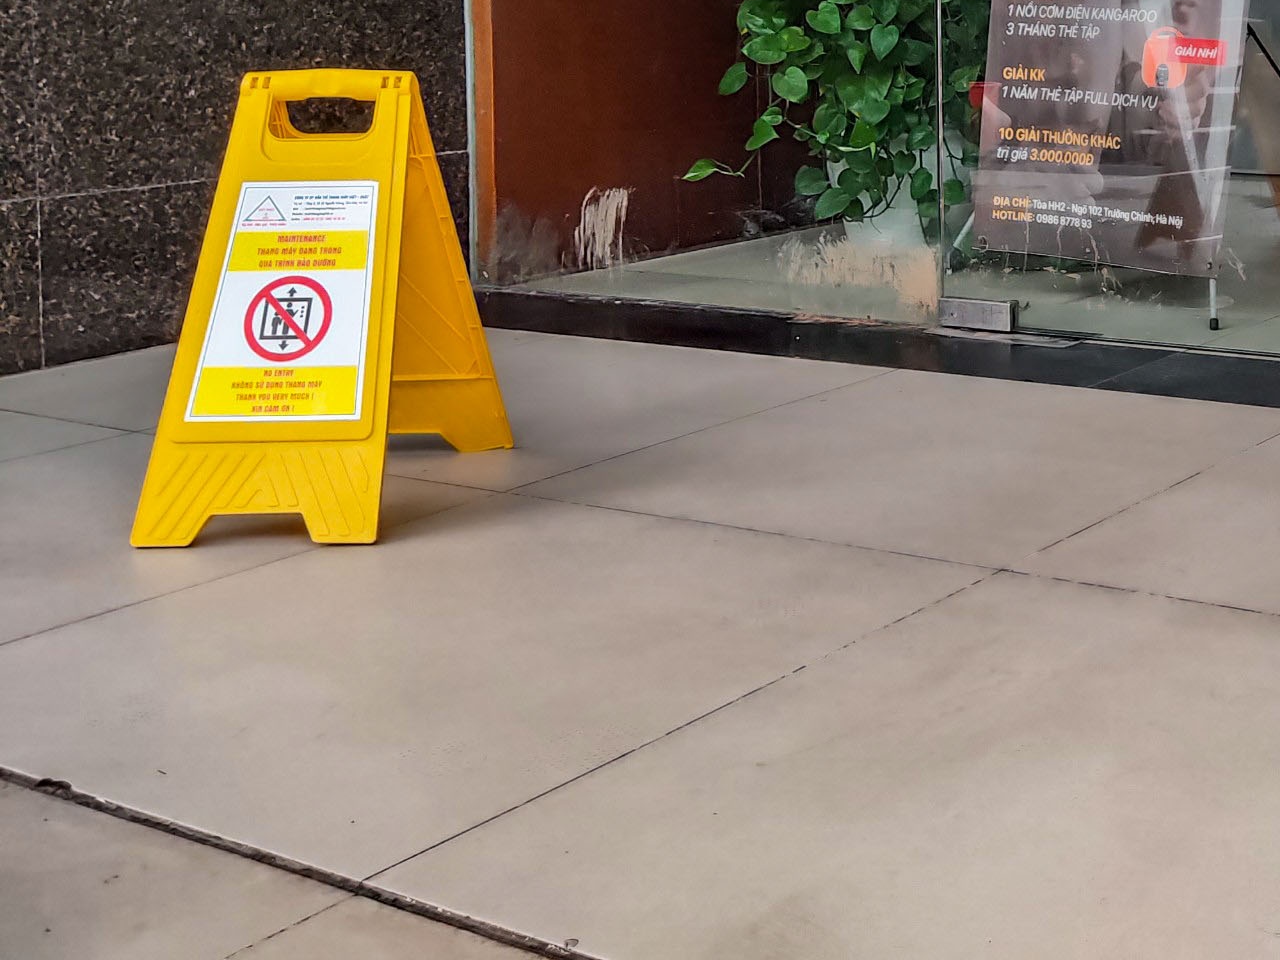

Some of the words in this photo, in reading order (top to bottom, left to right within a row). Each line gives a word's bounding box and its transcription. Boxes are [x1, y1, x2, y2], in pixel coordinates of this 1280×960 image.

[1007, 4, 1014, 16] 1
[1016, 1, 1037, 18] NỒI
[1038, 5, 1064, 19] CƠM
[1065, 4, 1090, 21] ĐIỆN
[1090, 7, 1158, 23] KANGAROO
[1002, 85, 1008, 98] 1
[1010, 84, 1038, 99] NĂM
[1063, 87, 1083, 105] TẬP
[1084, 90, 1109, 105] FULL
[1111, 93, 1139, 110] DỊCH
[1141, 94, 1159, 110] VỤ
[999, 127, 1014, 140] 10
[1015, 125, 1040, 142] GIẢI
[1041, 128, 1089, 147] THƯỞNG
[1090, 133, 1121, 150] KHÁC
[997, 146, 1010, 161] trị
[1010, 147, 1028, 162] giá
[991, 209, 1036, 223] HOTLINE:
[1036, 213, 1059, 225] 0986
[1081, 219, 1093, 229] 93
